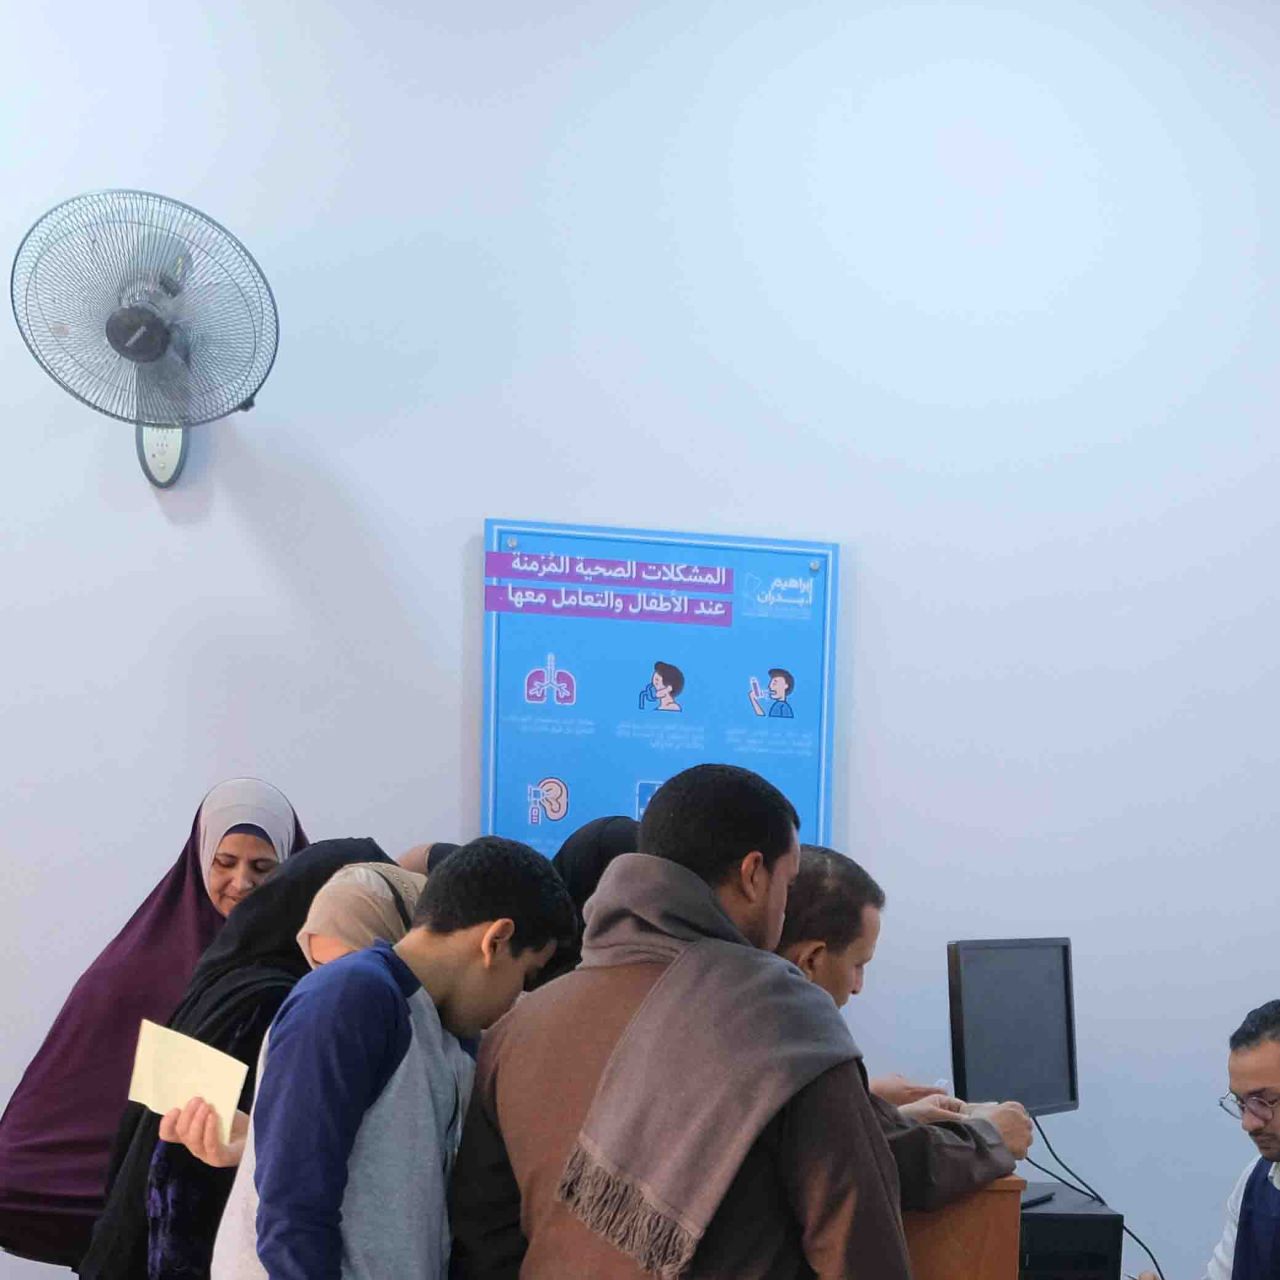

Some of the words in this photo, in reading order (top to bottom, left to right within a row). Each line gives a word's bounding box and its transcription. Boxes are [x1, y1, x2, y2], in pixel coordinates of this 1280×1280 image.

[575, 556, 636, 582] الصحية
[641, 563, 726, 585] المشكلات
[507, 583, 546, 608] معها
[551, 587, 624, 613] والتعامل
[628, 590, 689, 614] الأطفال
[694, 601, 726, 616] عند
